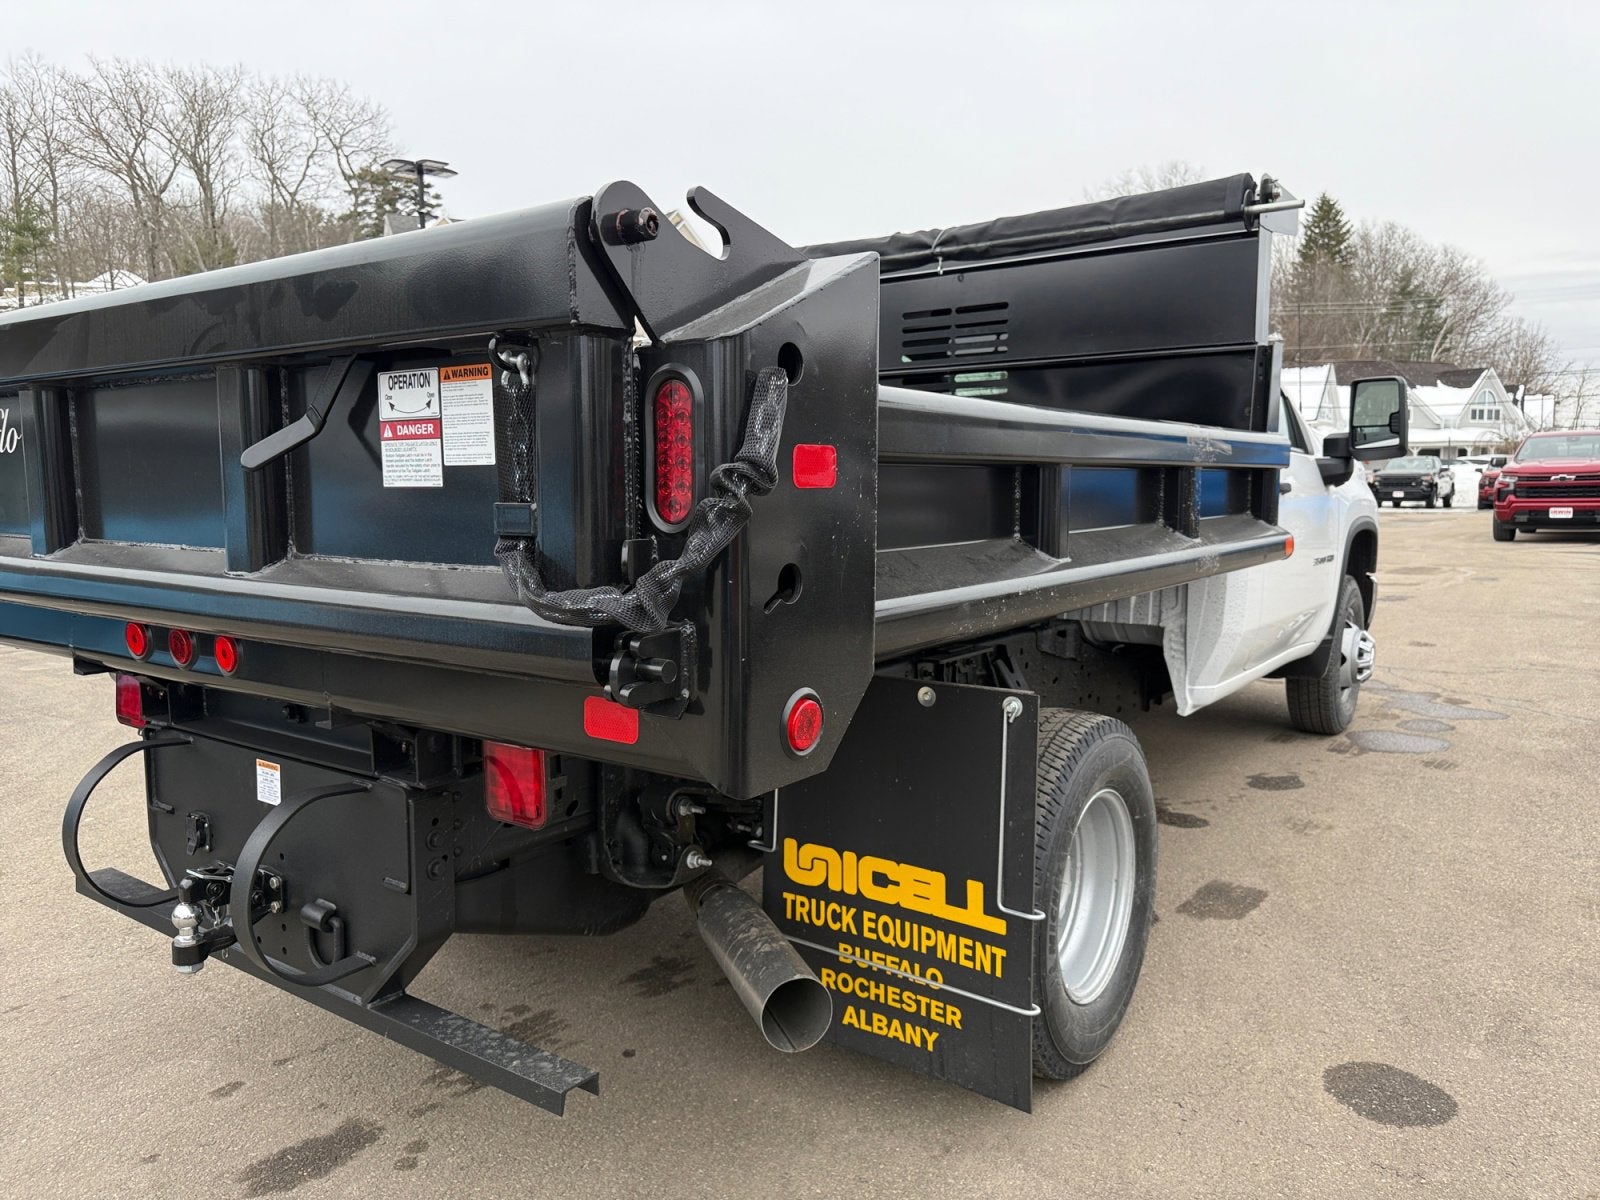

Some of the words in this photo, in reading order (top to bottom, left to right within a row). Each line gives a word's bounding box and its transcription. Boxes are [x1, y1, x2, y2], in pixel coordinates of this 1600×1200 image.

[388, 372, 431, 391] OPERATION
[451, 367, 489, 379] WARNING
[396, 423, 434, 436] DANGER
[783, 837, 1007, 936] UNICELL
[783, 891, 858, 936] TRUCK
[862, 910, 1007, 978] EQUIPMENT
[837, 942, 944, 989] BUFFALO
[820, 967, 963, 1030] ROCHESTER
[842, 1005, 940, 1053] ALBANY
